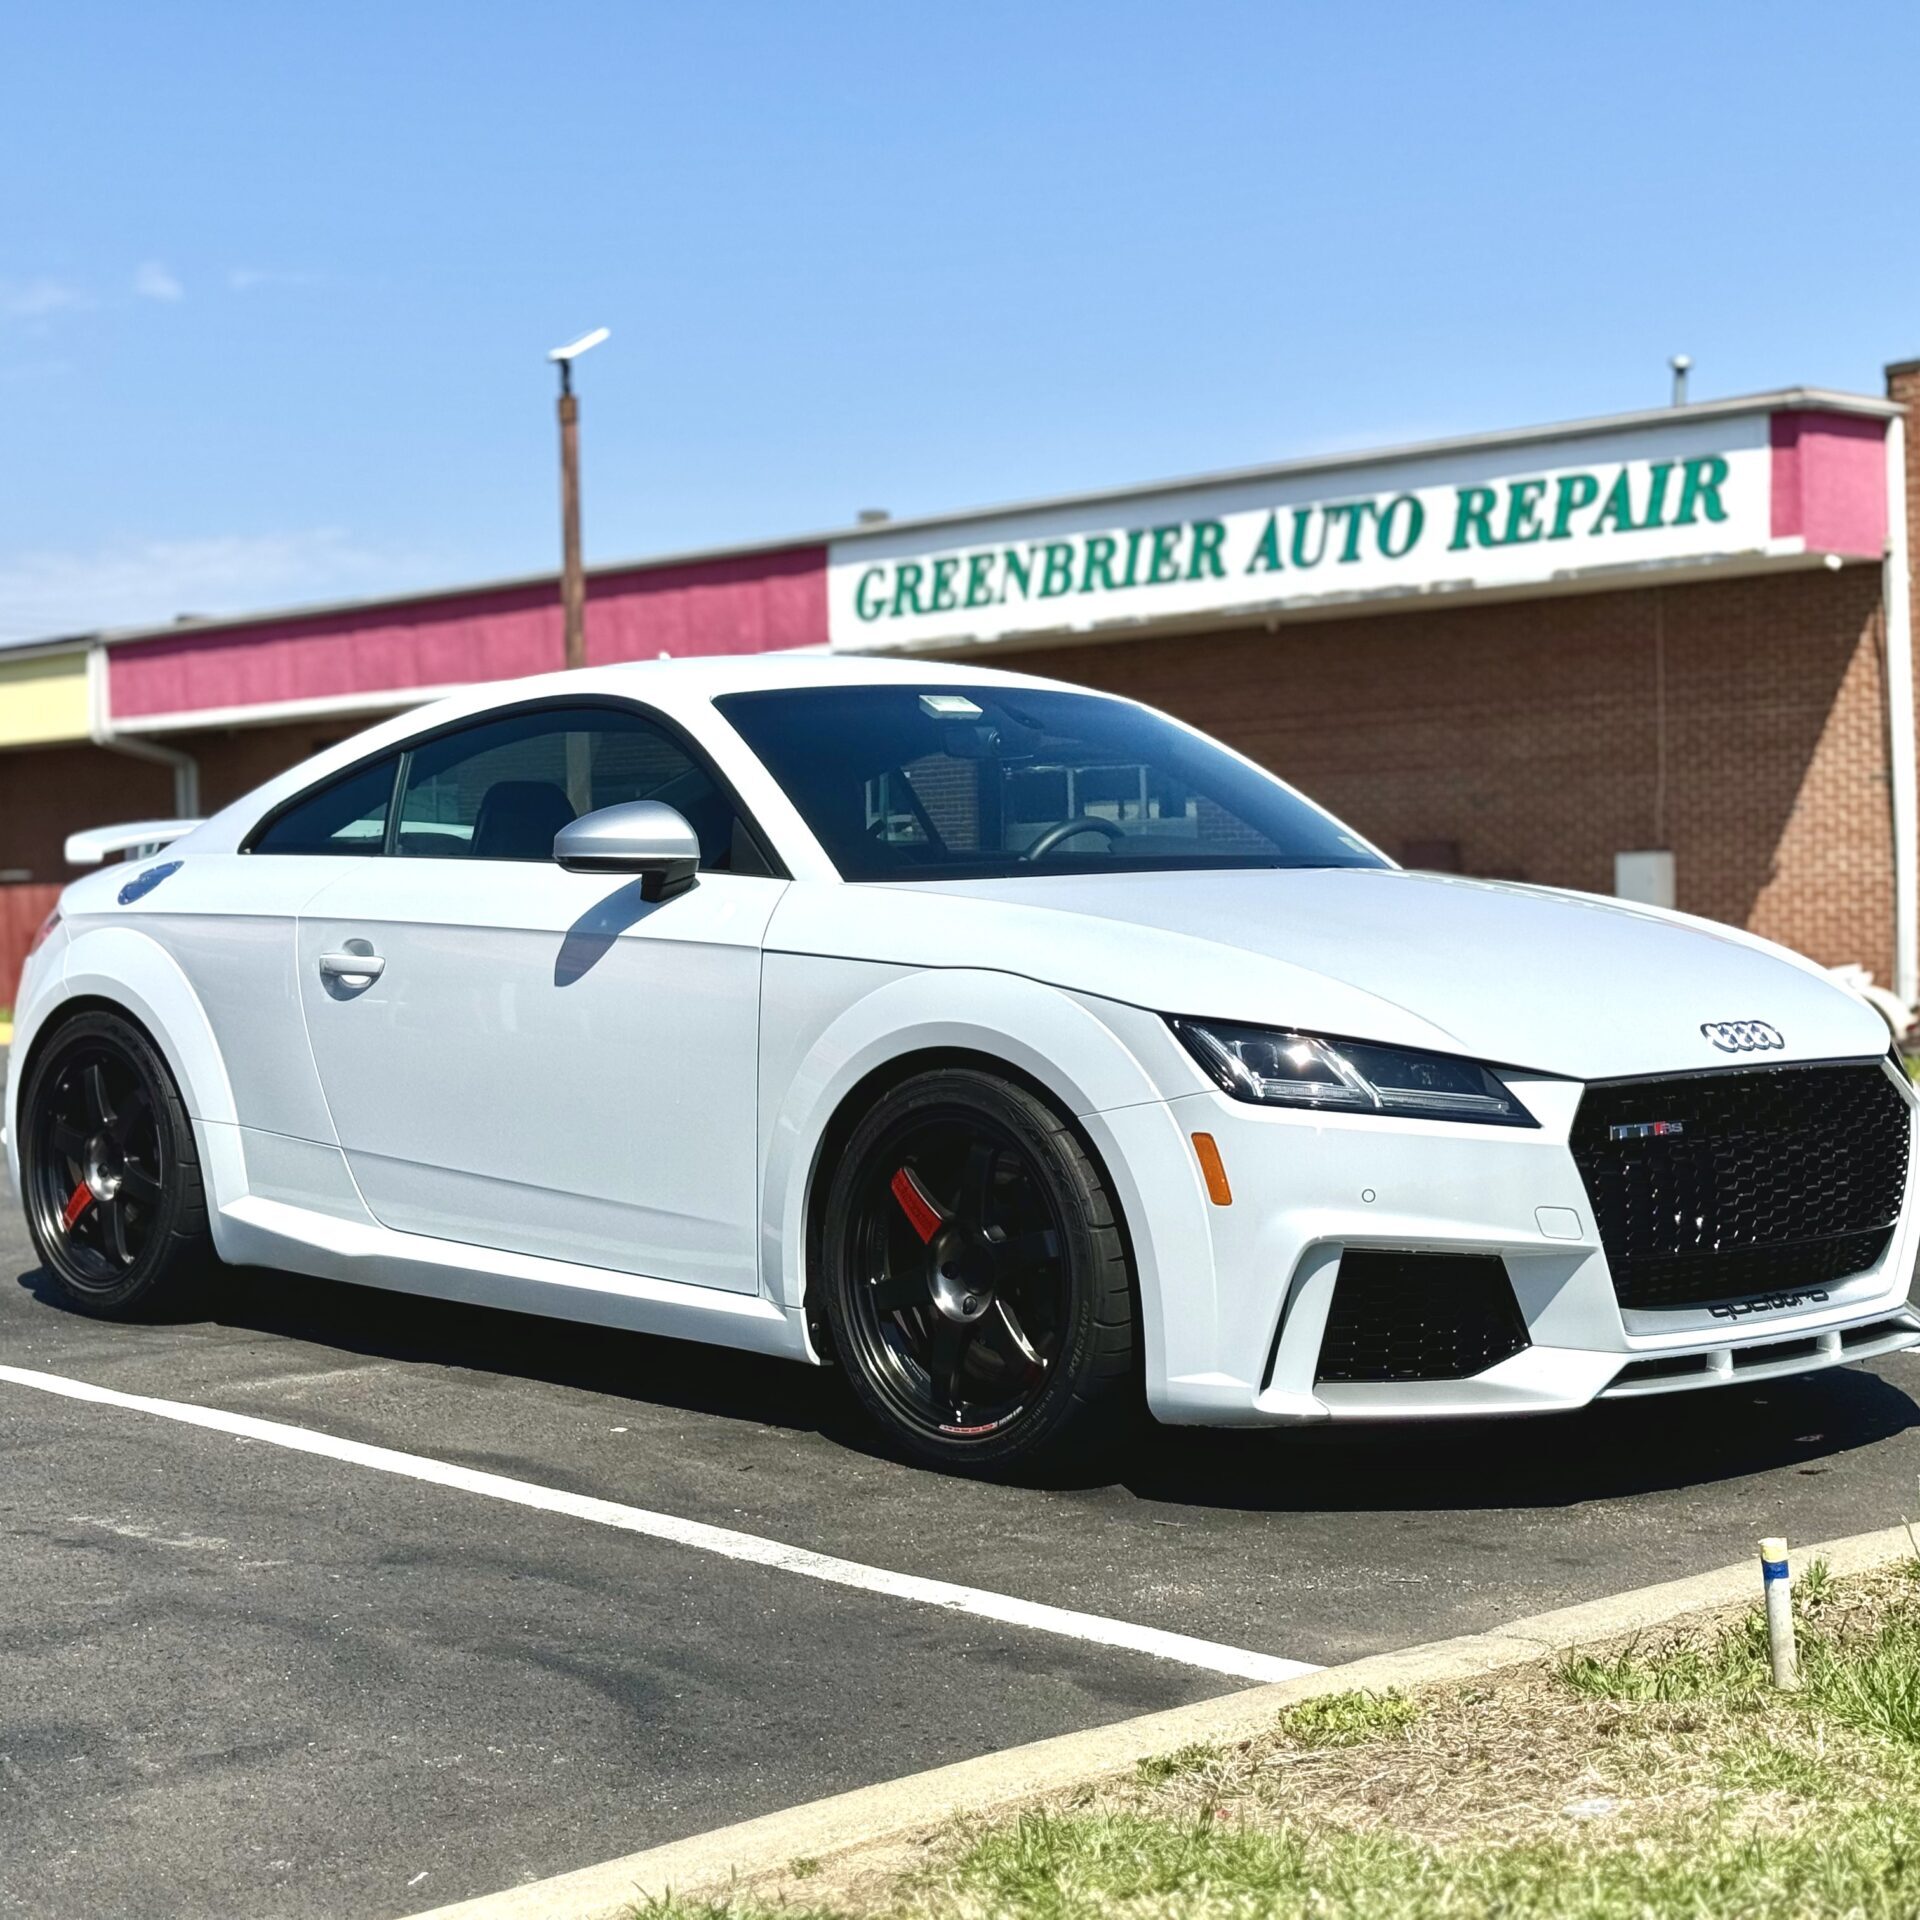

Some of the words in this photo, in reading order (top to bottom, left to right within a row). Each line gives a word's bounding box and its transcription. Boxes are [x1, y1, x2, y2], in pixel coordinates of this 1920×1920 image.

[854, 518, 1228, 622] GREENBRIER
[1245, 492, 1426, 574] AUTO
[1447, 454, 1730, 551] REPAIR
[1707, 1288, 1830, 1321] quattro
